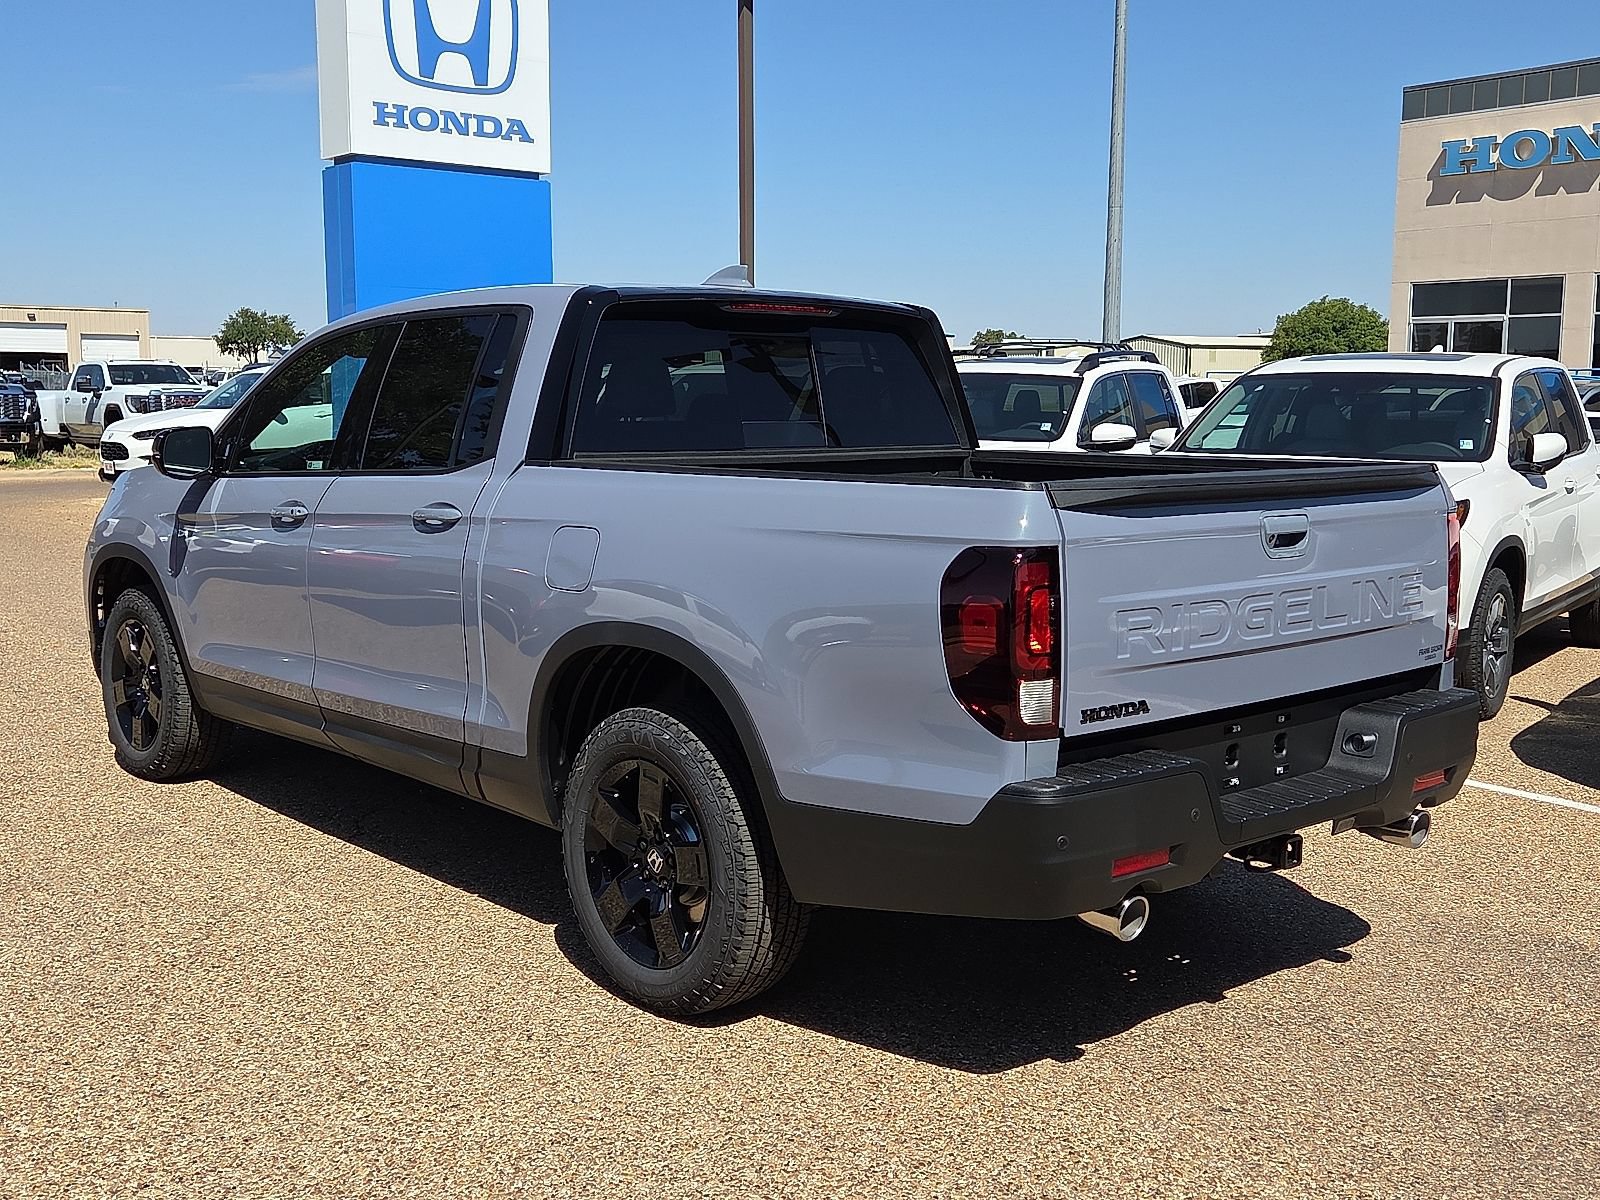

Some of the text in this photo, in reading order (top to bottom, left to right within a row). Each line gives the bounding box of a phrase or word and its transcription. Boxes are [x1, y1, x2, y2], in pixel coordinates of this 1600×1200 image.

[372, 101, 534, 143] HONDA
[1115, 571, 1424, 659] RIDGELINE
[1080, 699, 1151, 725] HONDA
